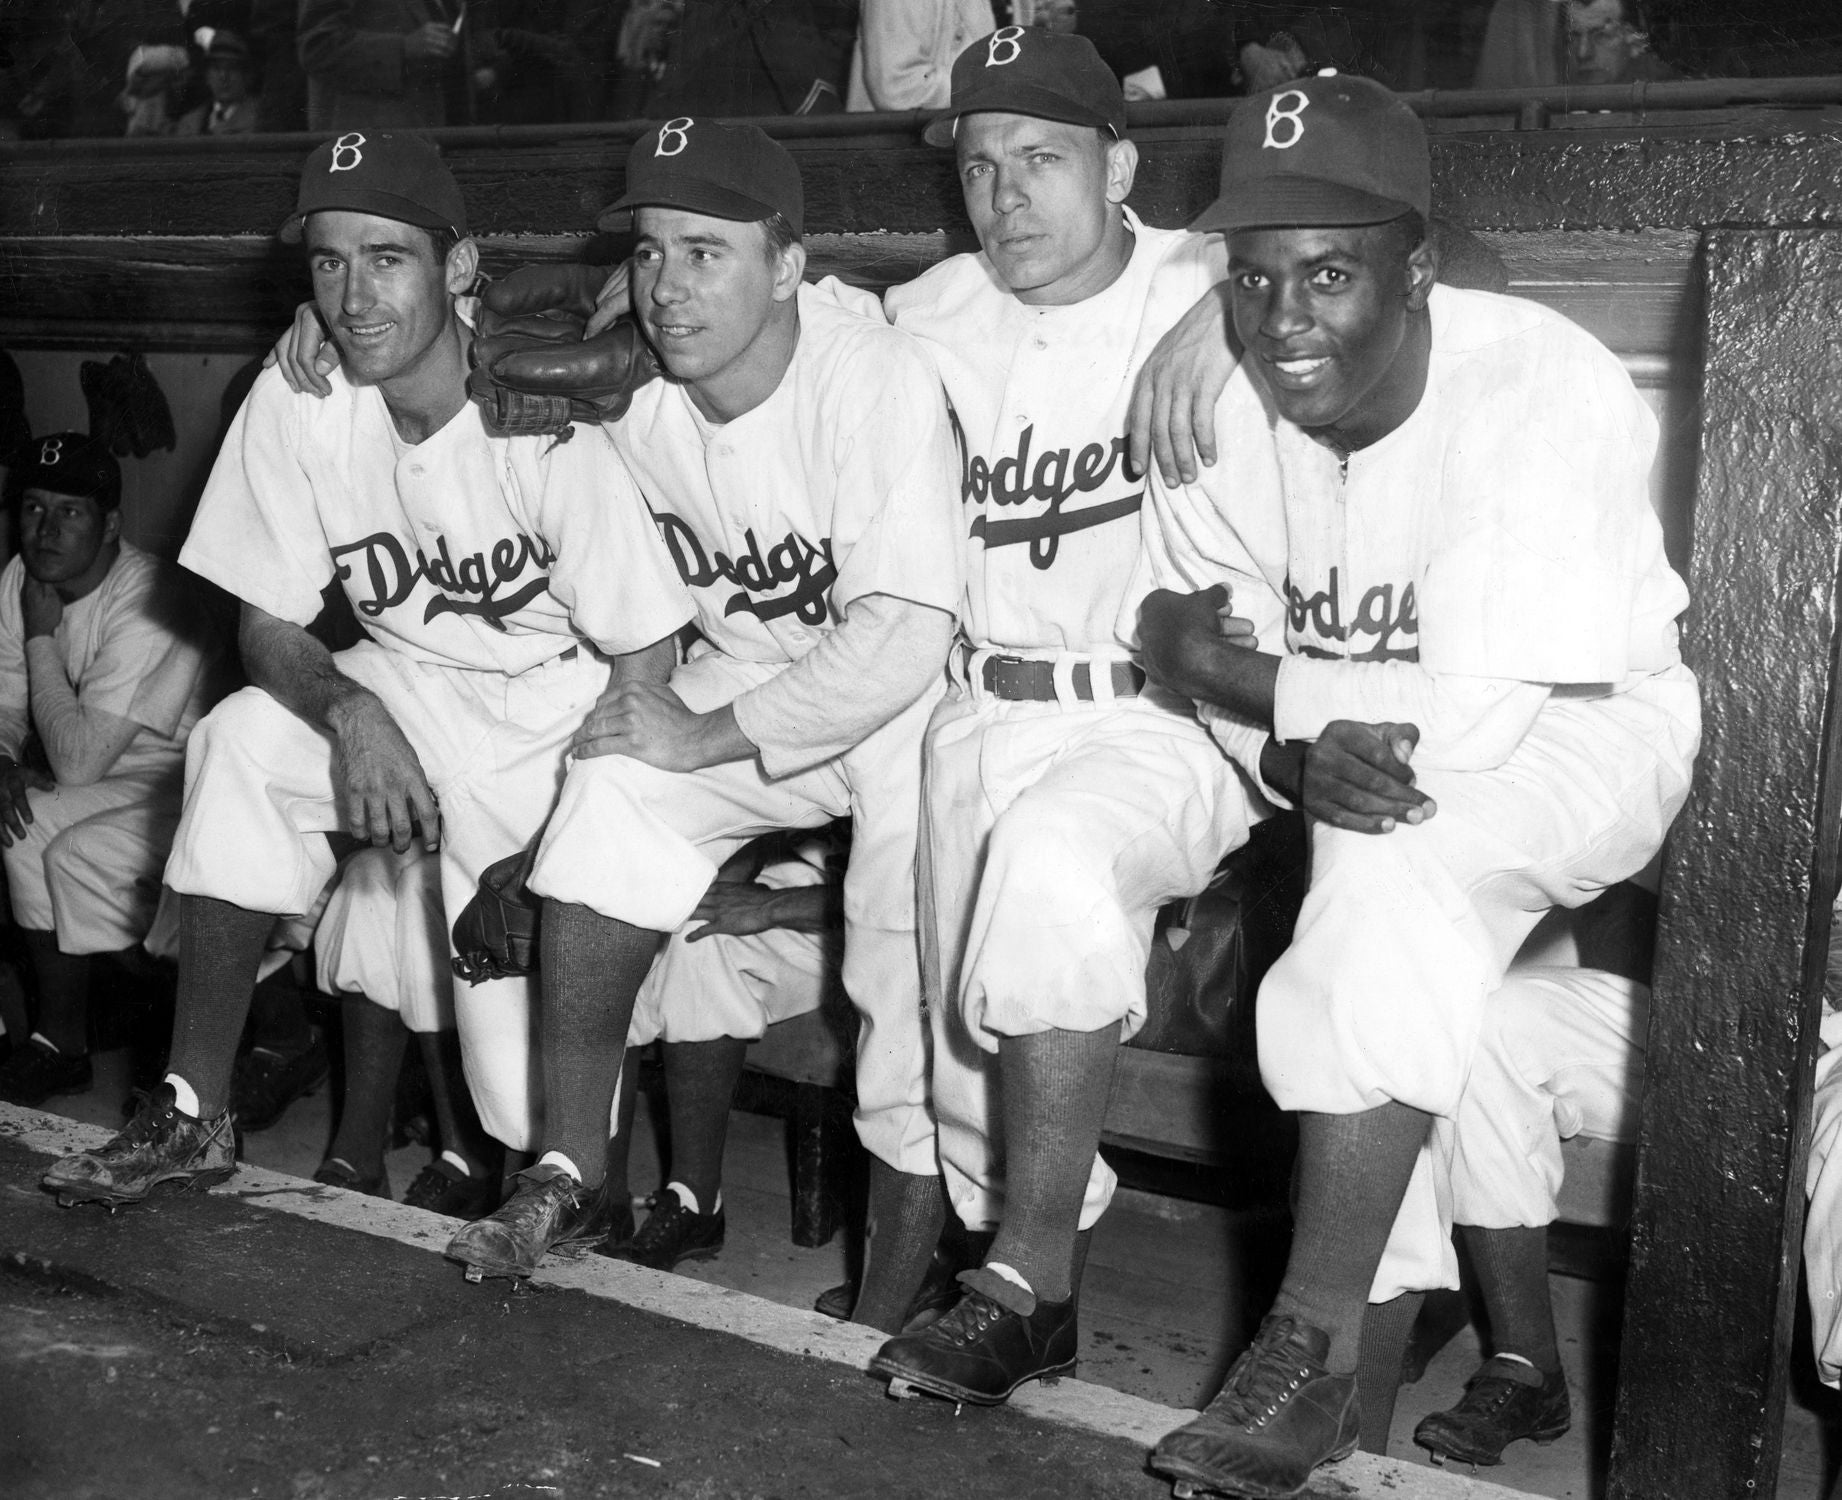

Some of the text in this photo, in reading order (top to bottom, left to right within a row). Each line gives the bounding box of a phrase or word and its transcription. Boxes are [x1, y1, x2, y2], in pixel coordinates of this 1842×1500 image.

[985, 25, 1025, 68] B
[654, 116, 695, 158] B
[1262, 90, 1310, 149] B
[329, 132, 366, 173] B
[40, 439, 63, 465] B
[948, 409, 1147, 571] odger
